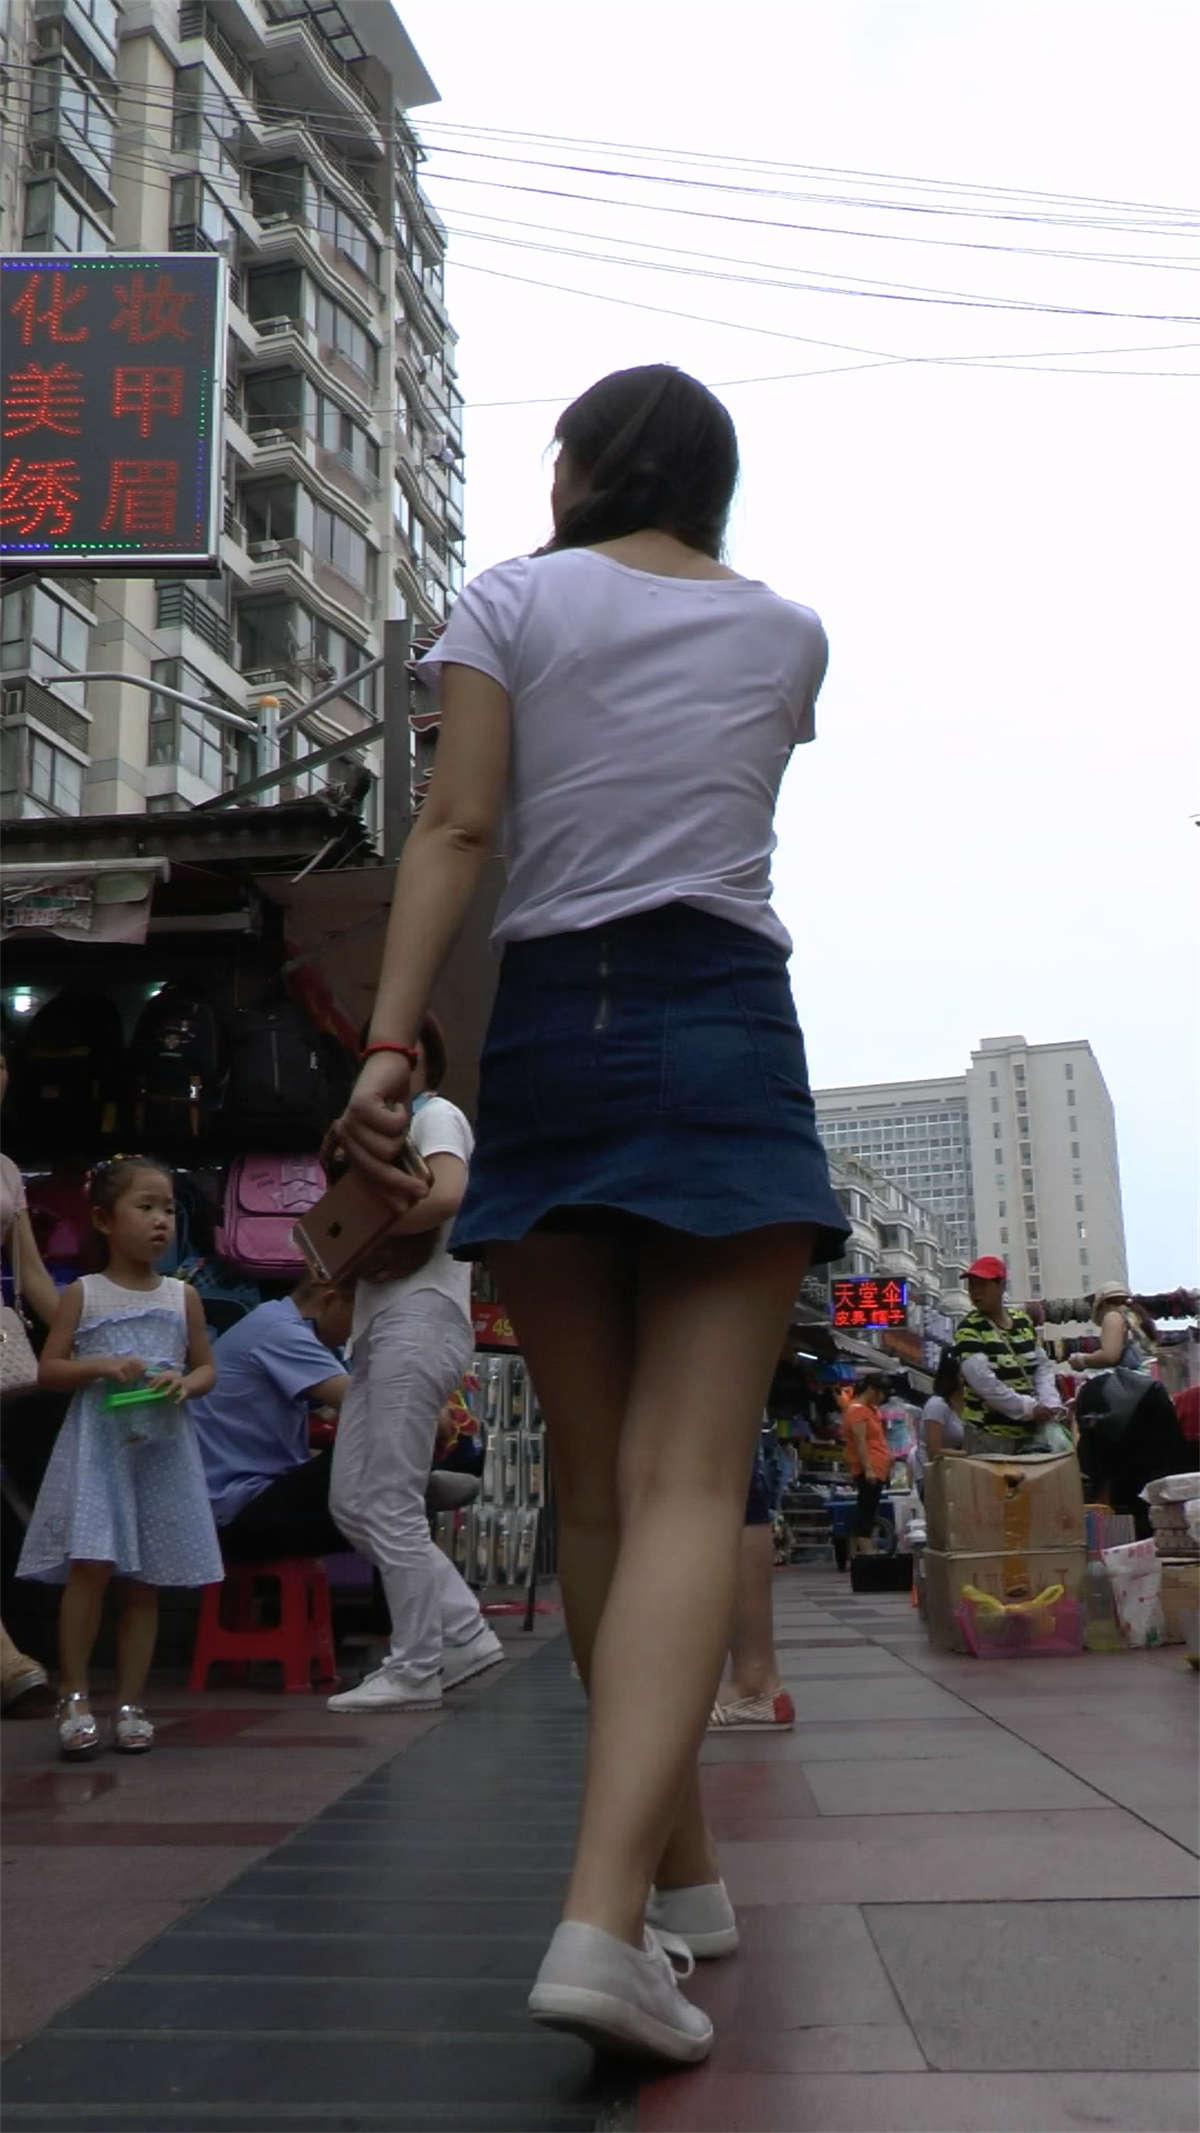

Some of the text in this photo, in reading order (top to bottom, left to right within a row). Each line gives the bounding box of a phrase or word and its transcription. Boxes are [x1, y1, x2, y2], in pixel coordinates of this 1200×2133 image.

[10, 273, 196, 346] 化妆
[4, 362, 184, 440] 美甲
[0, 457, 180, 535] 绣眉
[834, 1281, 902, 1309] 天堂伞
